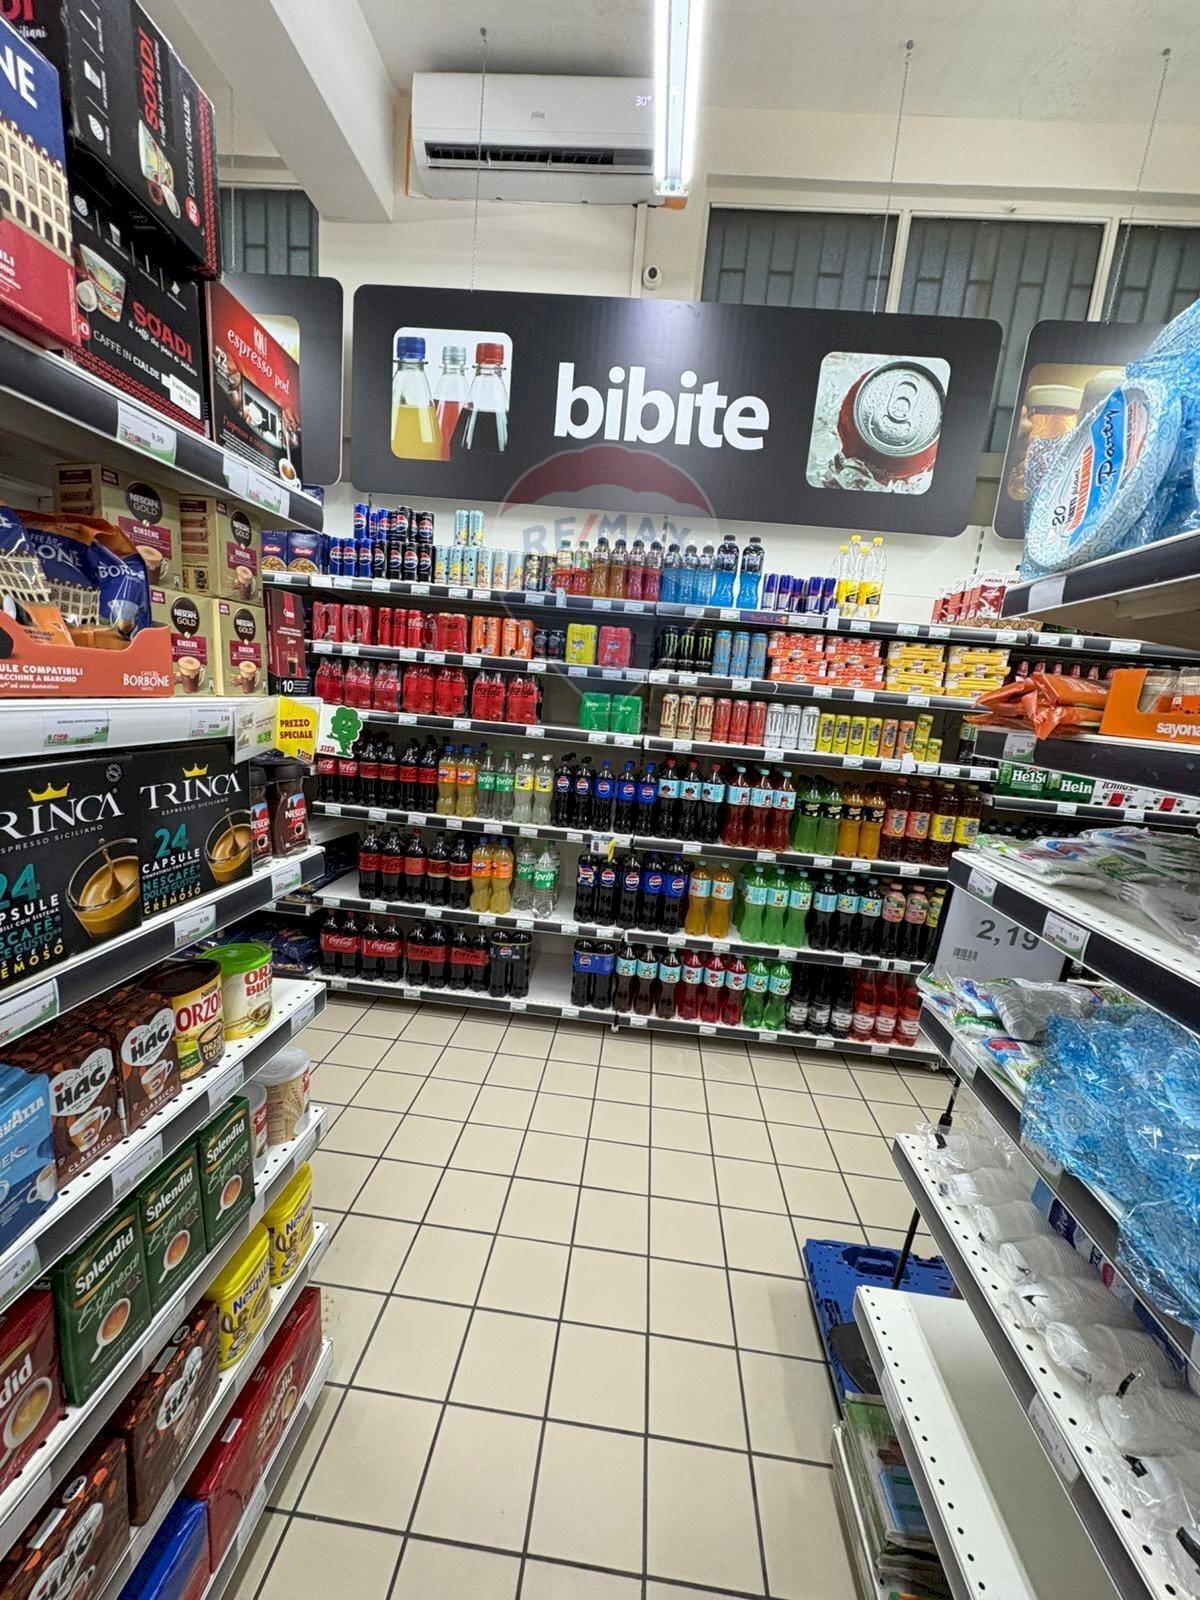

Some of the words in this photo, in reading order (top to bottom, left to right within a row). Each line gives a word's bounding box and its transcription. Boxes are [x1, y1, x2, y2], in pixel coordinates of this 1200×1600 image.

[133, 301, 193, 364] SOADI
[93, 329, 121, 354] CAFFÈ
[122, 348, 133, 362] IN
[132, 355, 160, 379] CIALDE
[216, 345, 228, 369] 72
[228, 329, 273, 379] espresso
[274, 373, 290, 395] pod
[554, 362, 770, 450] bibite
[133, 502, 158, 516] GOLD
[1052, 505, 1067, 527] 20
[133, 525, 160, 540] GINSENG
[176, 618, 197, 627] GOLD
[237, 626, 254, 635] GOLD
[22, 665, 84, 676] COMPATIBILI
[44, 675, 77, 683] MARCHIO
[123, 674, 170, 687] BORBONE
[281, 679, 295, 693] 10
[280, 718, 310, 728] PREZZO
[280, 730, 313, 739] SPECIALE
[319, 744, 336, 754] SISA
[140, 773, 243, 811] TRINCA
[0, 792, 125, 840] RINCA
[161, 804, 195, 816] ESPRESSO
[54, 825, 103, 842] SICILIANO
[155, 823, 190, 858] 24
[142, 848, 200, 874] CAPSULE
[0, 863, 40, 909] 24
[143, 886, 171, 900] DOLCE
[144, 886, 201, 915] CREMOSO
[15, 917, 31, 927] CON
[32, 908, 60, 921] SISTEMA
[15, 933, 54, 955] GUSTO
[976, 919, 1040, 950] 2,19
[0, 945, 64, 980] EMOSO
[137, 1013, 168, 1042] CAFFÈ
[130, 1023, 170, 1063] HAG
[64, 1056, 105, 1088] CAFFÈ
[55, 1066, 107, 1114] HAG
[140, 1085, 175, 1117] CLASSICO
[68, 1134, 113, 1174] CLASSICO
[206, 1119, 245, 1164] Splendid
[146, 1167, 194, 1223] Splendid
[75, 1227, 134, 1296] Splendid
